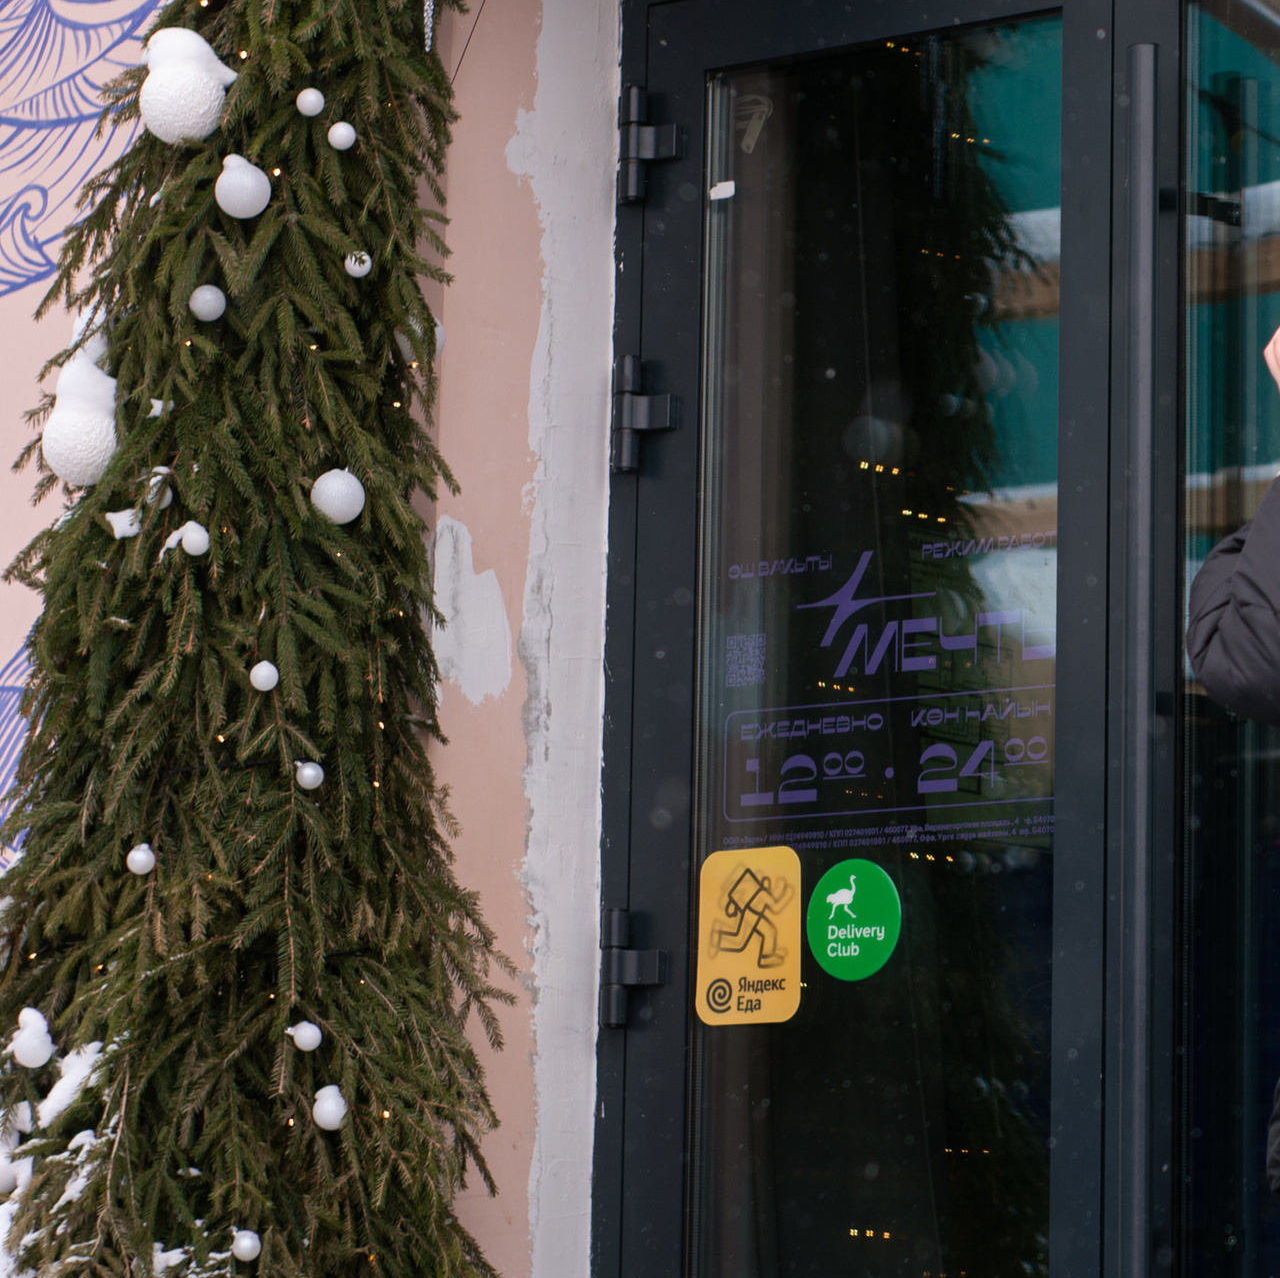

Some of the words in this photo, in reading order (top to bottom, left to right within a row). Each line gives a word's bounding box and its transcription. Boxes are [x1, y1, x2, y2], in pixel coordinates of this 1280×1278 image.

[920, 536, 994, 560] РЕЖИМ
[997, 530, 1057, 554] РАБОТ
[740, 712, 884, 741] ЕЖЕДНЕВНО
[827, 923, 885, 942] Delivery
[827, 942, 860, 958] Club
[738, 976, 786, 995] Яндекс
[736, 995, 762, 1013] Еда
